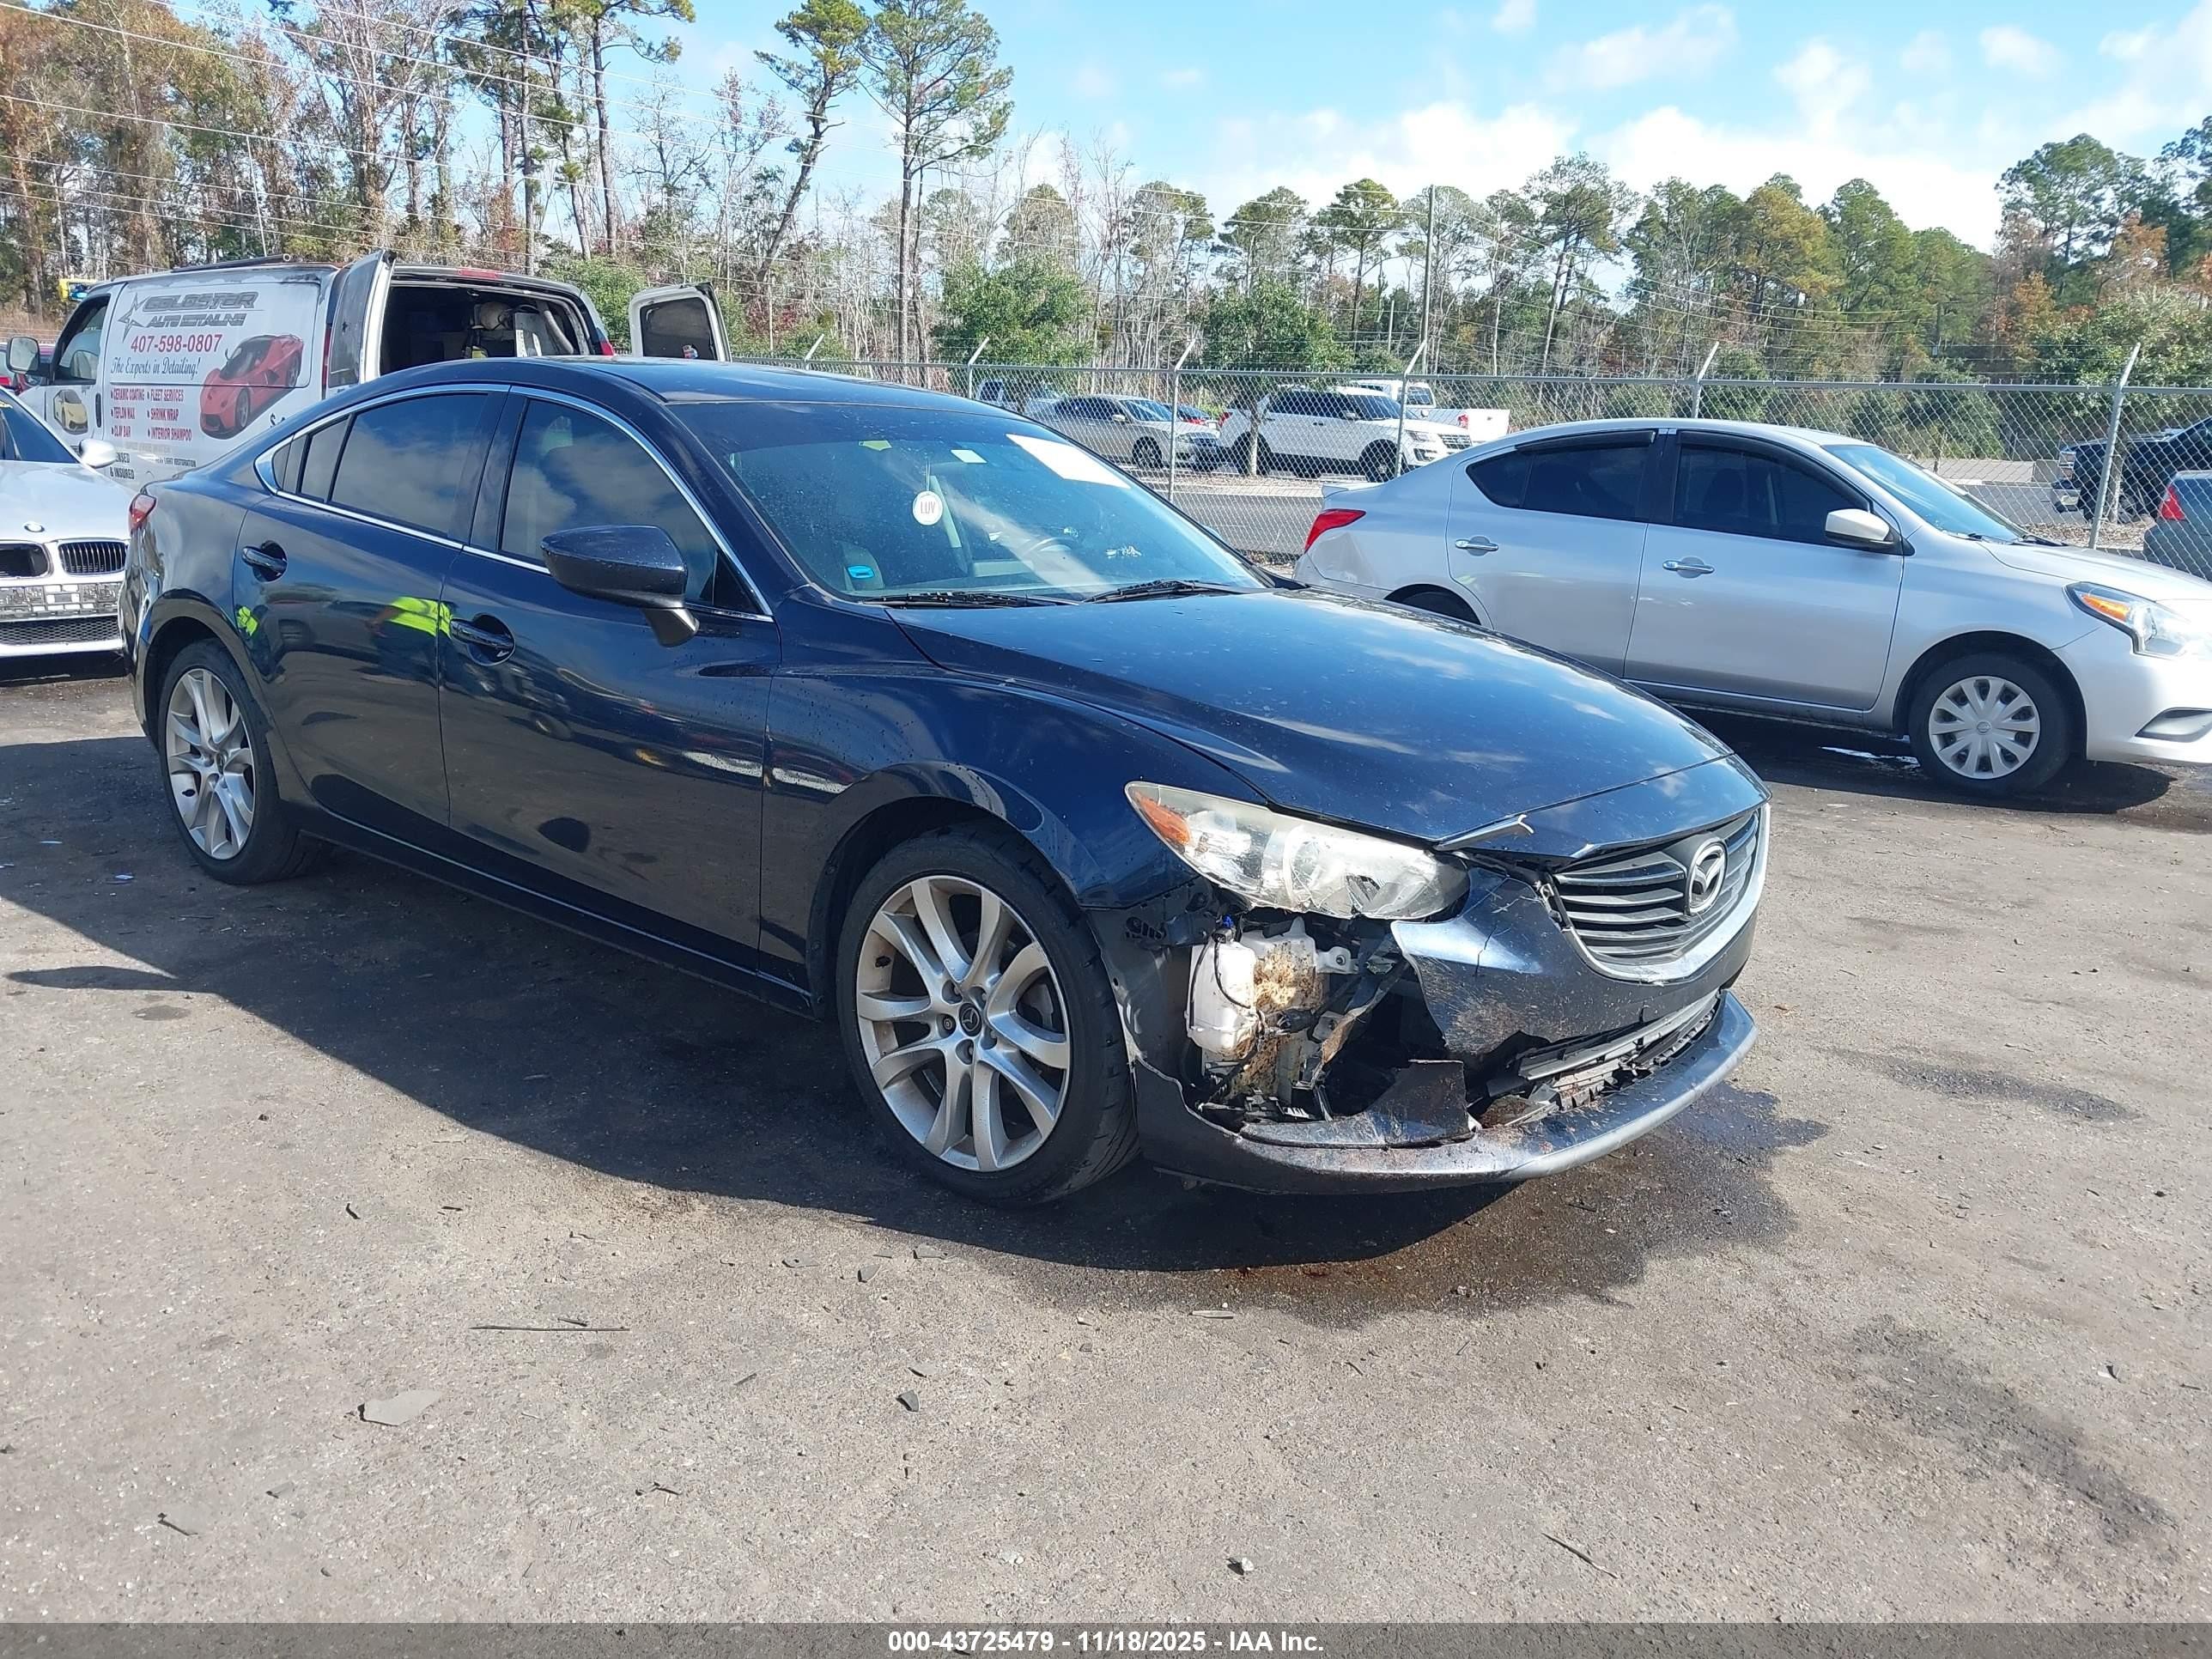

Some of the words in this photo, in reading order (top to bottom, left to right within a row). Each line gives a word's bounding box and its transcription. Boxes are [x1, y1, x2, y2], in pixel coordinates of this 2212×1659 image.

[131, 334, 223, 353] 407-598-0807
[111, 356, 124, 374] The
[125, 356, 150, 379] Experts
[153, 358, 161, 374] in
[161, 356, 201, 380] Detailing!
[113, 388, 129, 401] CERAMIC
[130, 388, 145, 401] COATING
[151, 389, 163, 402] FLEET
[164, 389, 184, 402] SERVICES
[113, 407, 127, 419] TEFLON
[127, 407, 136, 420] WAX
[150, 408, 167, 421] SHRINK
[167, 409, 179, 422] WRAP
[114, 425, 123, 437] CLAY
[123, 426, 131, 438] BAR
[151, 426, 171, 440] INTERIOR
[171, 428, 192, 441] SHAMPOO
[114, 468, 135, 480] INSURED
[921, 501, 936, 514] LUV
